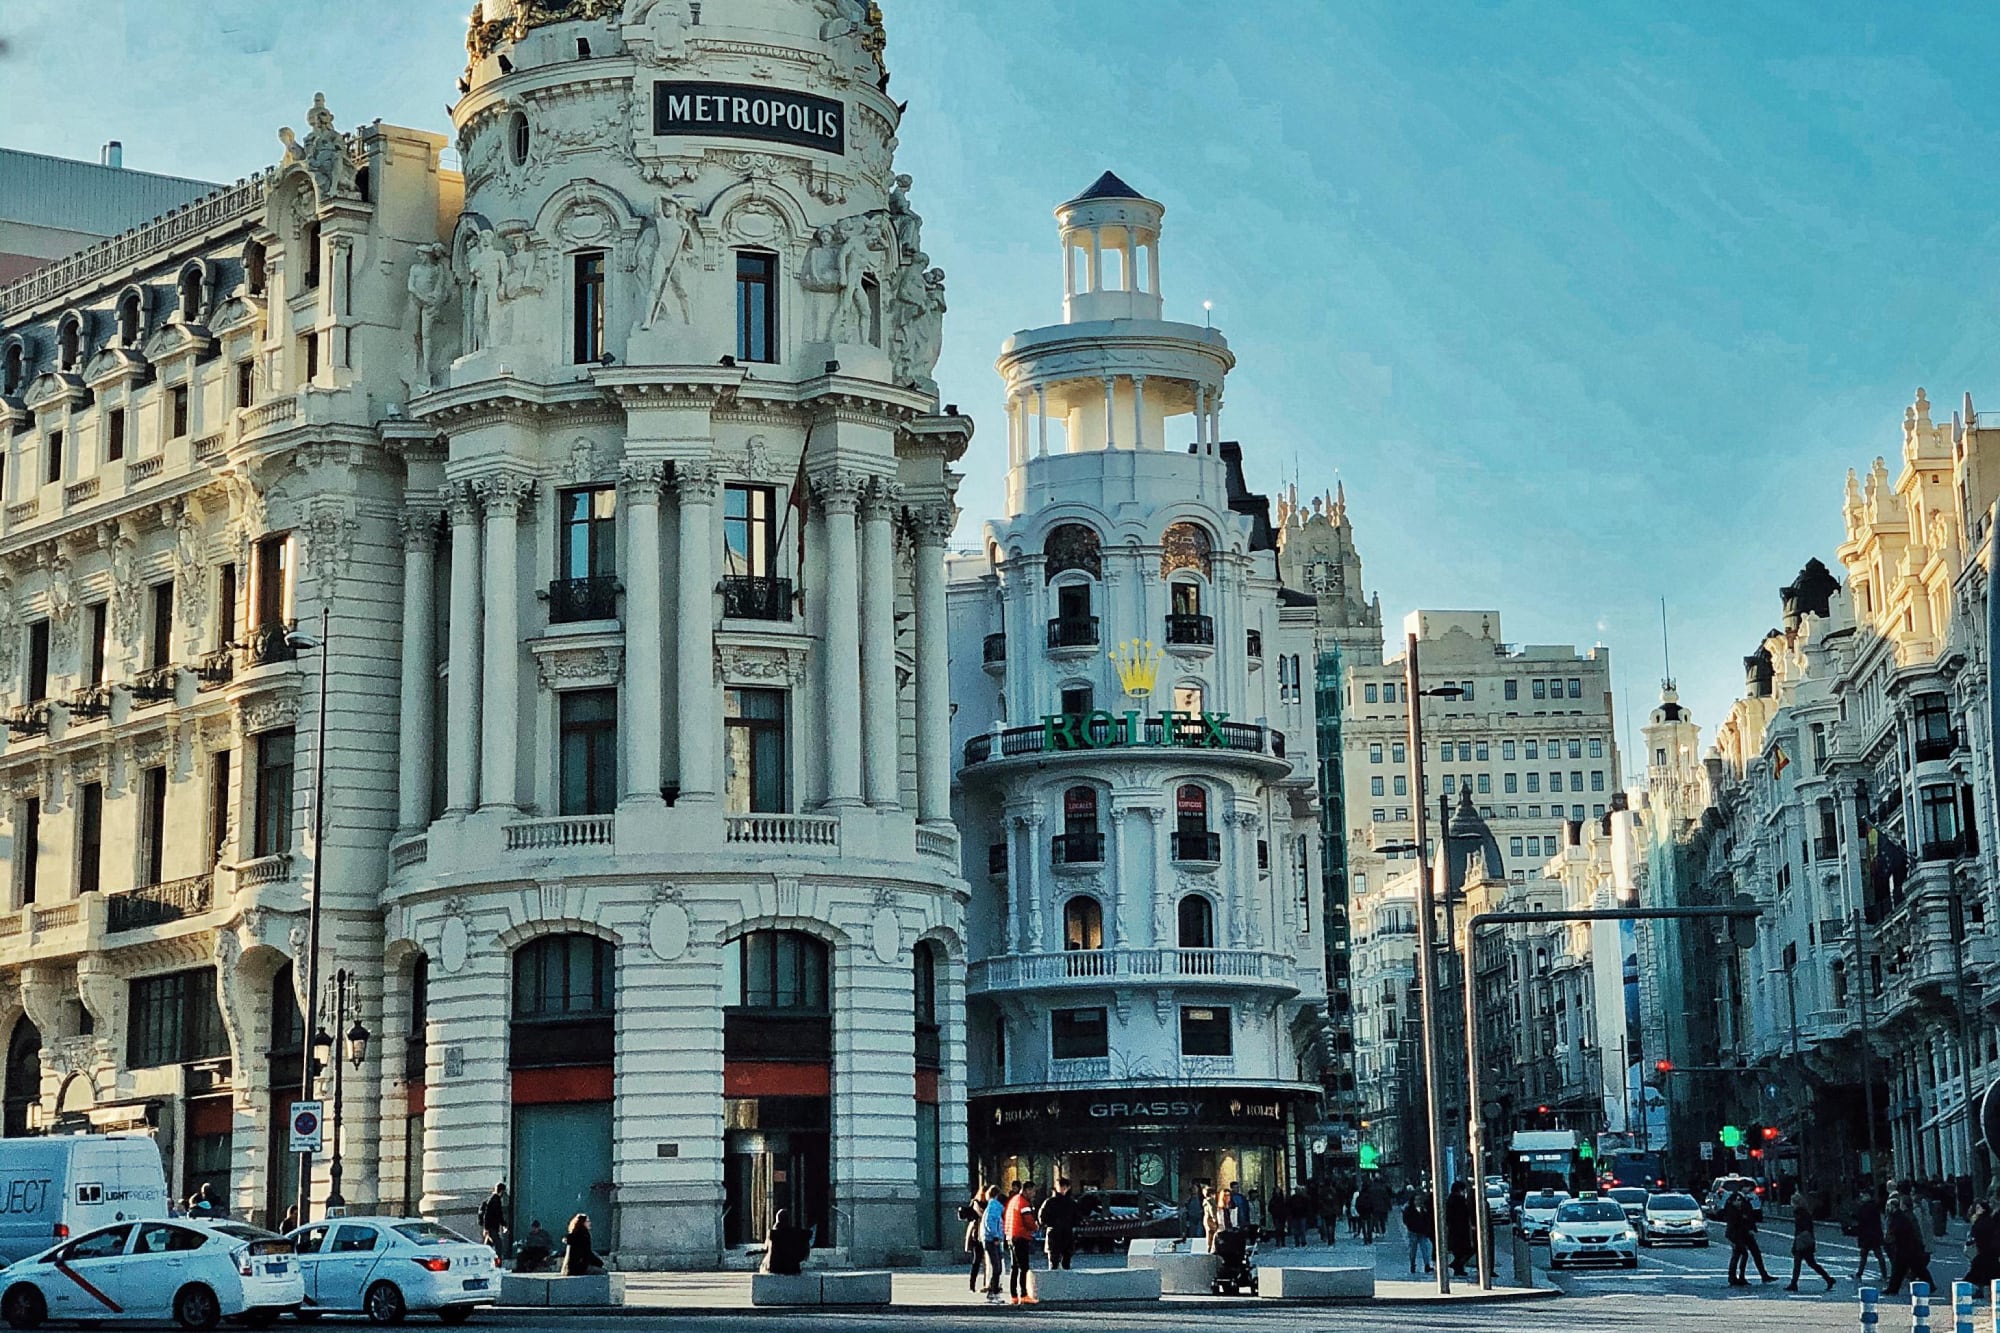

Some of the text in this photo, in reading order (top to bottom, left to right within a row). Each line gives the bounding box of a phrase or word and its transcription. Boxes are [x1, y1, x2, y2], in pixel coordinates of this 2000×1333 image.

[668, 95, 837, 138] METROPOLIS
[1040, 709, 1230, 751] ROLEX
[1089, 1102, 1204, 1118] GRASSY
